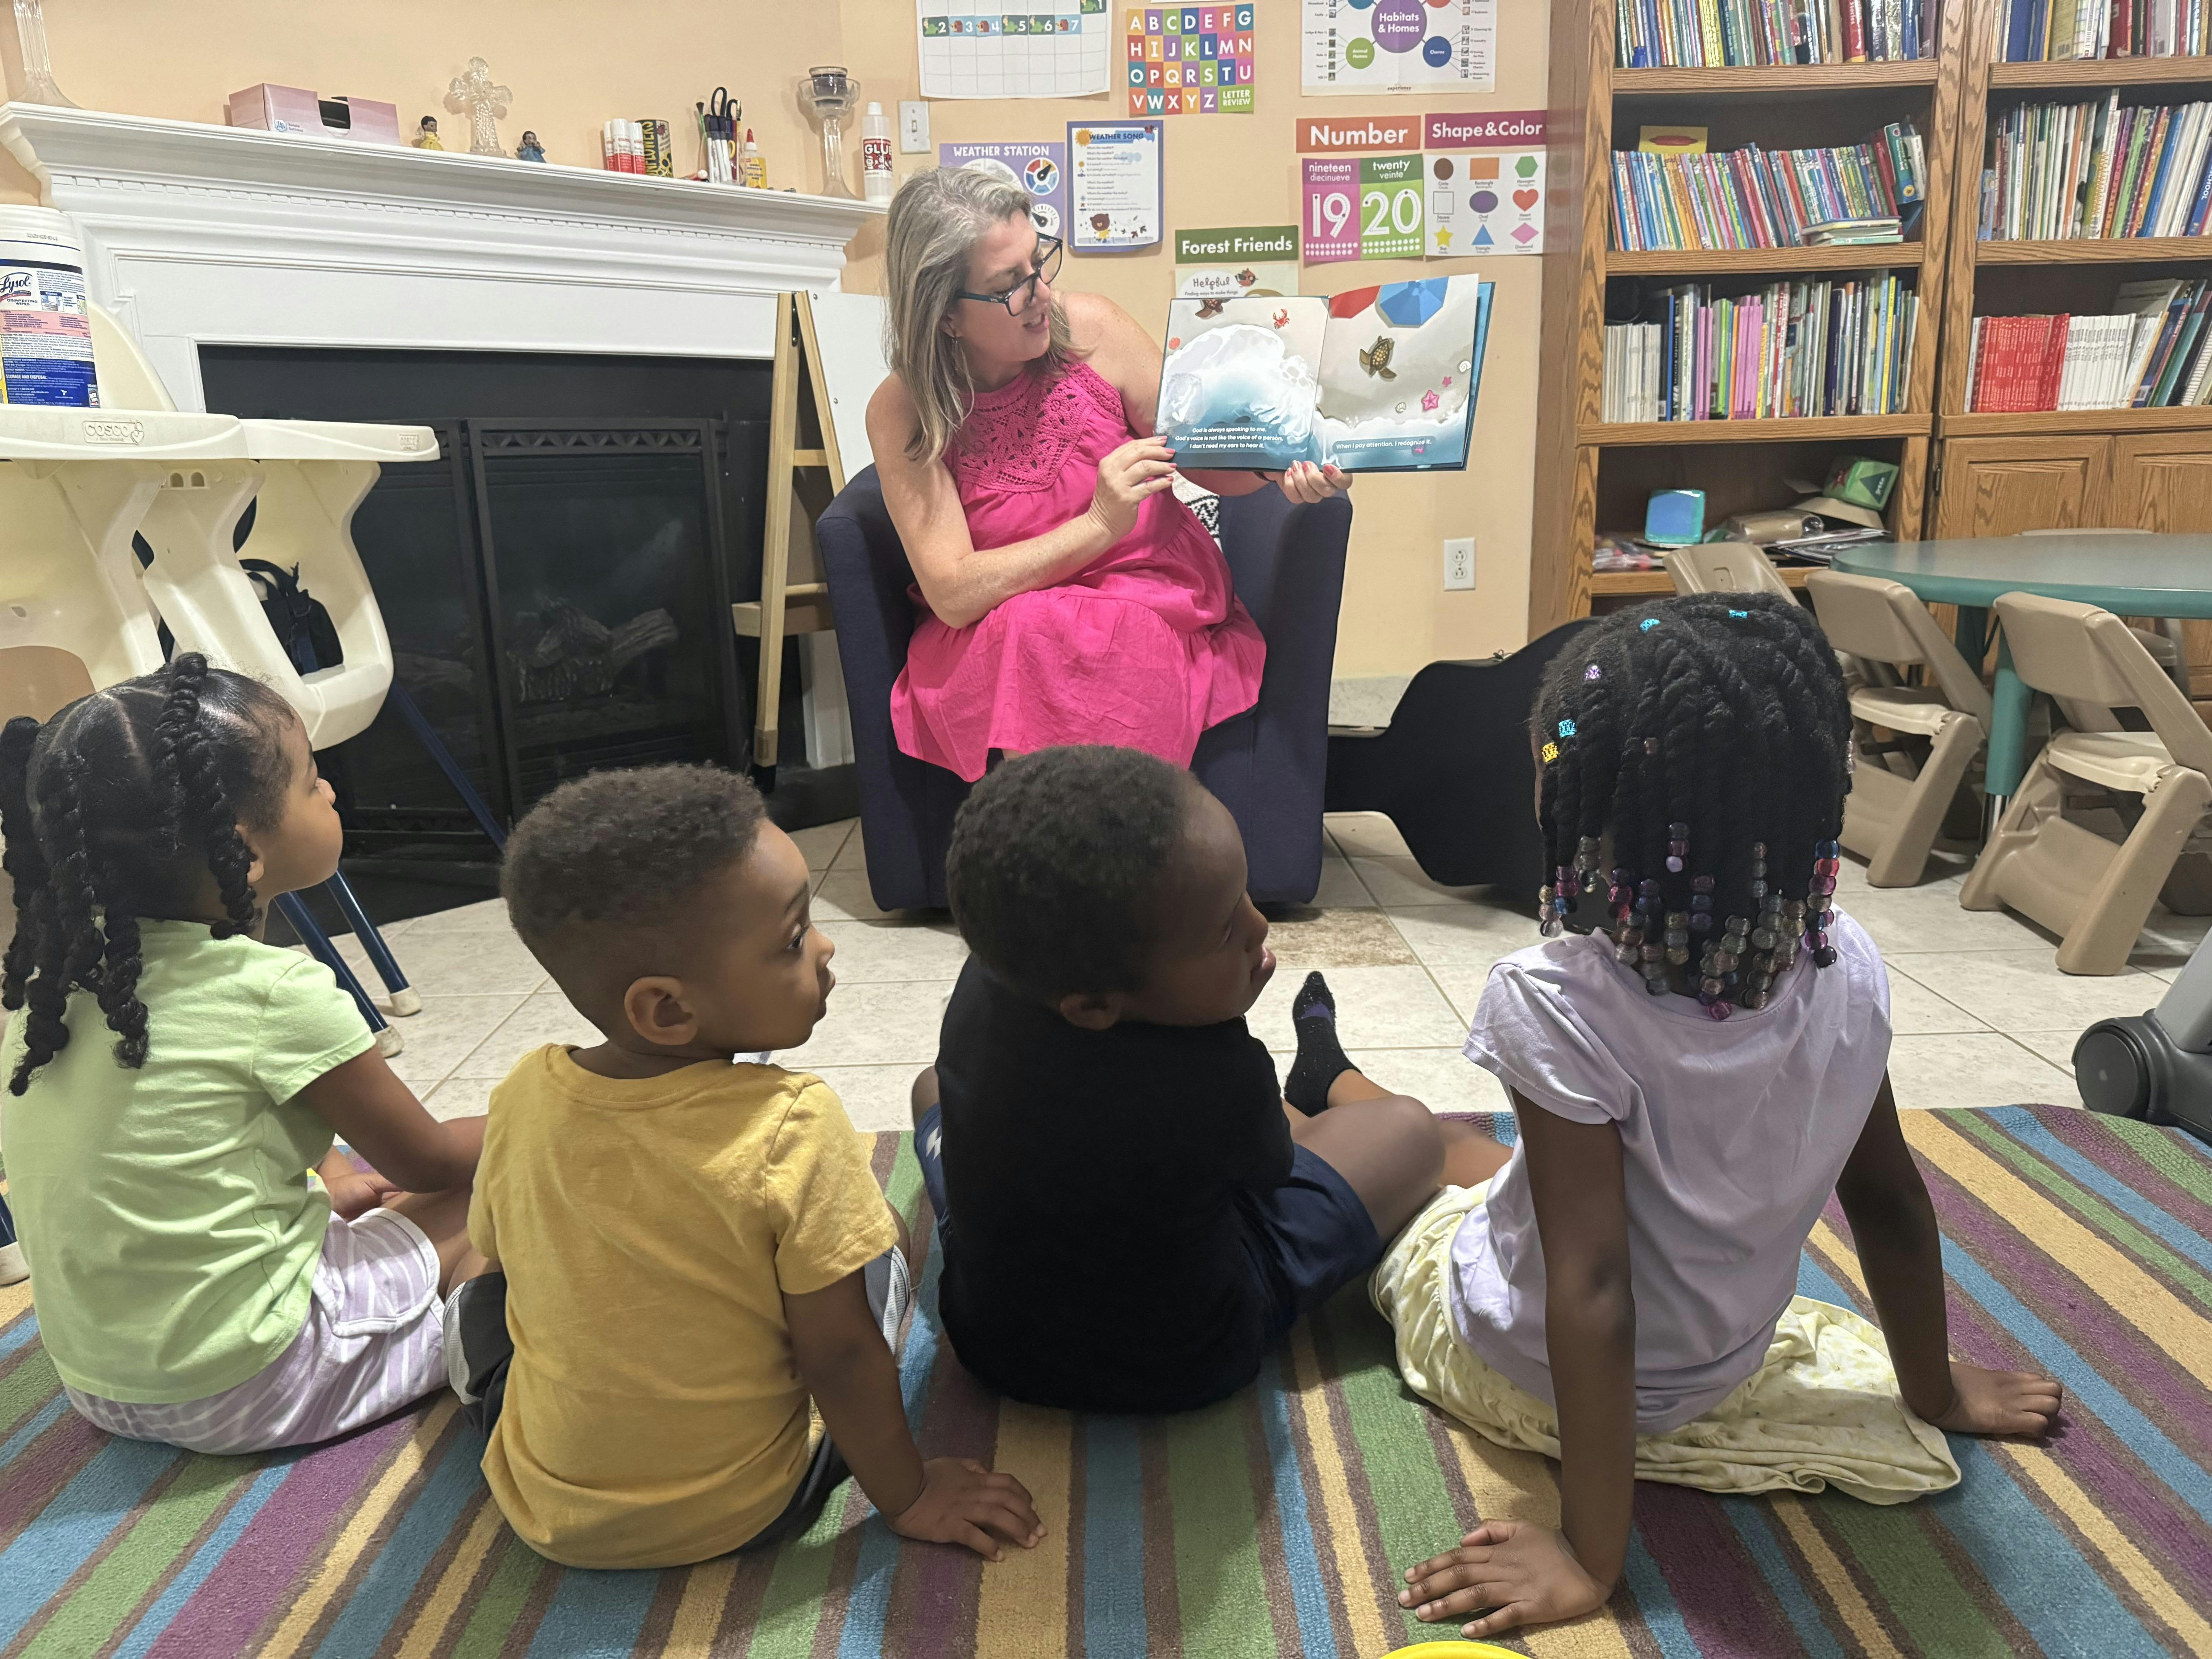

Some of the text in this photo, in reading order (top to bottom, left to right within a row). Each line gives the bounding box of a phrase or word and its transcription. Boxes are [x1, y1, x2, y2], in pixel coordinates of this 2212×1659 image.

[1098, 0, 1103, 9] 1
[1130, 11, 1251, 30] A B C D E F G
[1379, 12, 1419, 22] Habitats
[938, 20, 1079, 33] 2 3 4 5 6 7
[1378, 24, 1419, 33] & Homes
[1131, 38, 1251, 57] H I J K L M N
[1130, 65, 1250, 84] O P Q R S T U
[1223, 90, 1250, 98] LETTER
[1132, 94, 1214, 109] V W X Y Z
[1310, 122, 1408, 146] Number
[953, 146, 1049, 156] WEATHER STATION
[1309, 162, 1351, 172] nineteen
[1373, 160, 1410, 171] twenty
[1312, 193, 1351, 239] 19
[1362, 189, 1422, 236] 20
[1182, 235, 1293, 255] Forest Friends
[0, 275, 29, 293] Lysol
[1193, 276, 1230, 290] Helpful
[85, 423, 129, 437] COSCO
